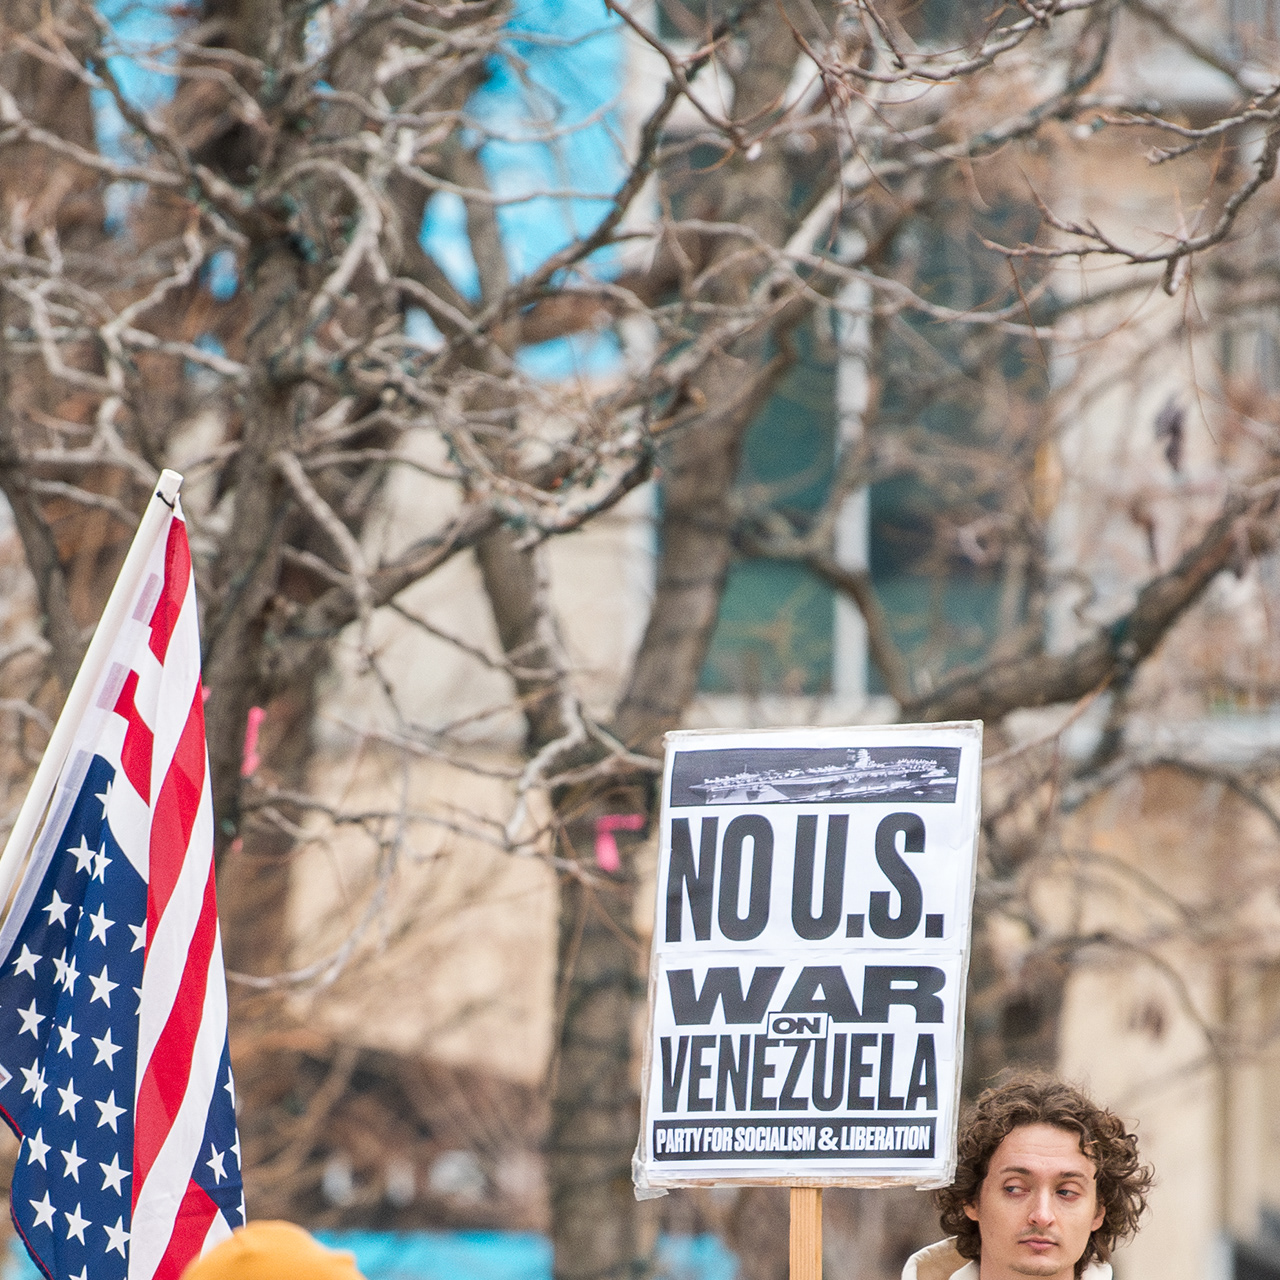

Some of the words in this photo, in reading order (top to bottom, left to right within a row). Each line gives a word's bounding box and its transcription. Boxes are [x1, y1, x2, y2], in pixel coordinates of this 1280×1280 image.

[665, 813, 775, 943] NO
[791, 811, 945, 941] U.S.
[666, 965, 947, 1026] WAR
[771, 1017, 820, 1035] ON
[660, 1033, 939, 1113] VENEZUELA
[656, 1127, 703, 1154] PARTY
[703, 1126, 733, 1153] FOR
[733, 1125, 816, 1152] SOCIALISM
[818, 1127, 839, 1150] &
[841, 1124, 931, 1152] LIBERATION
